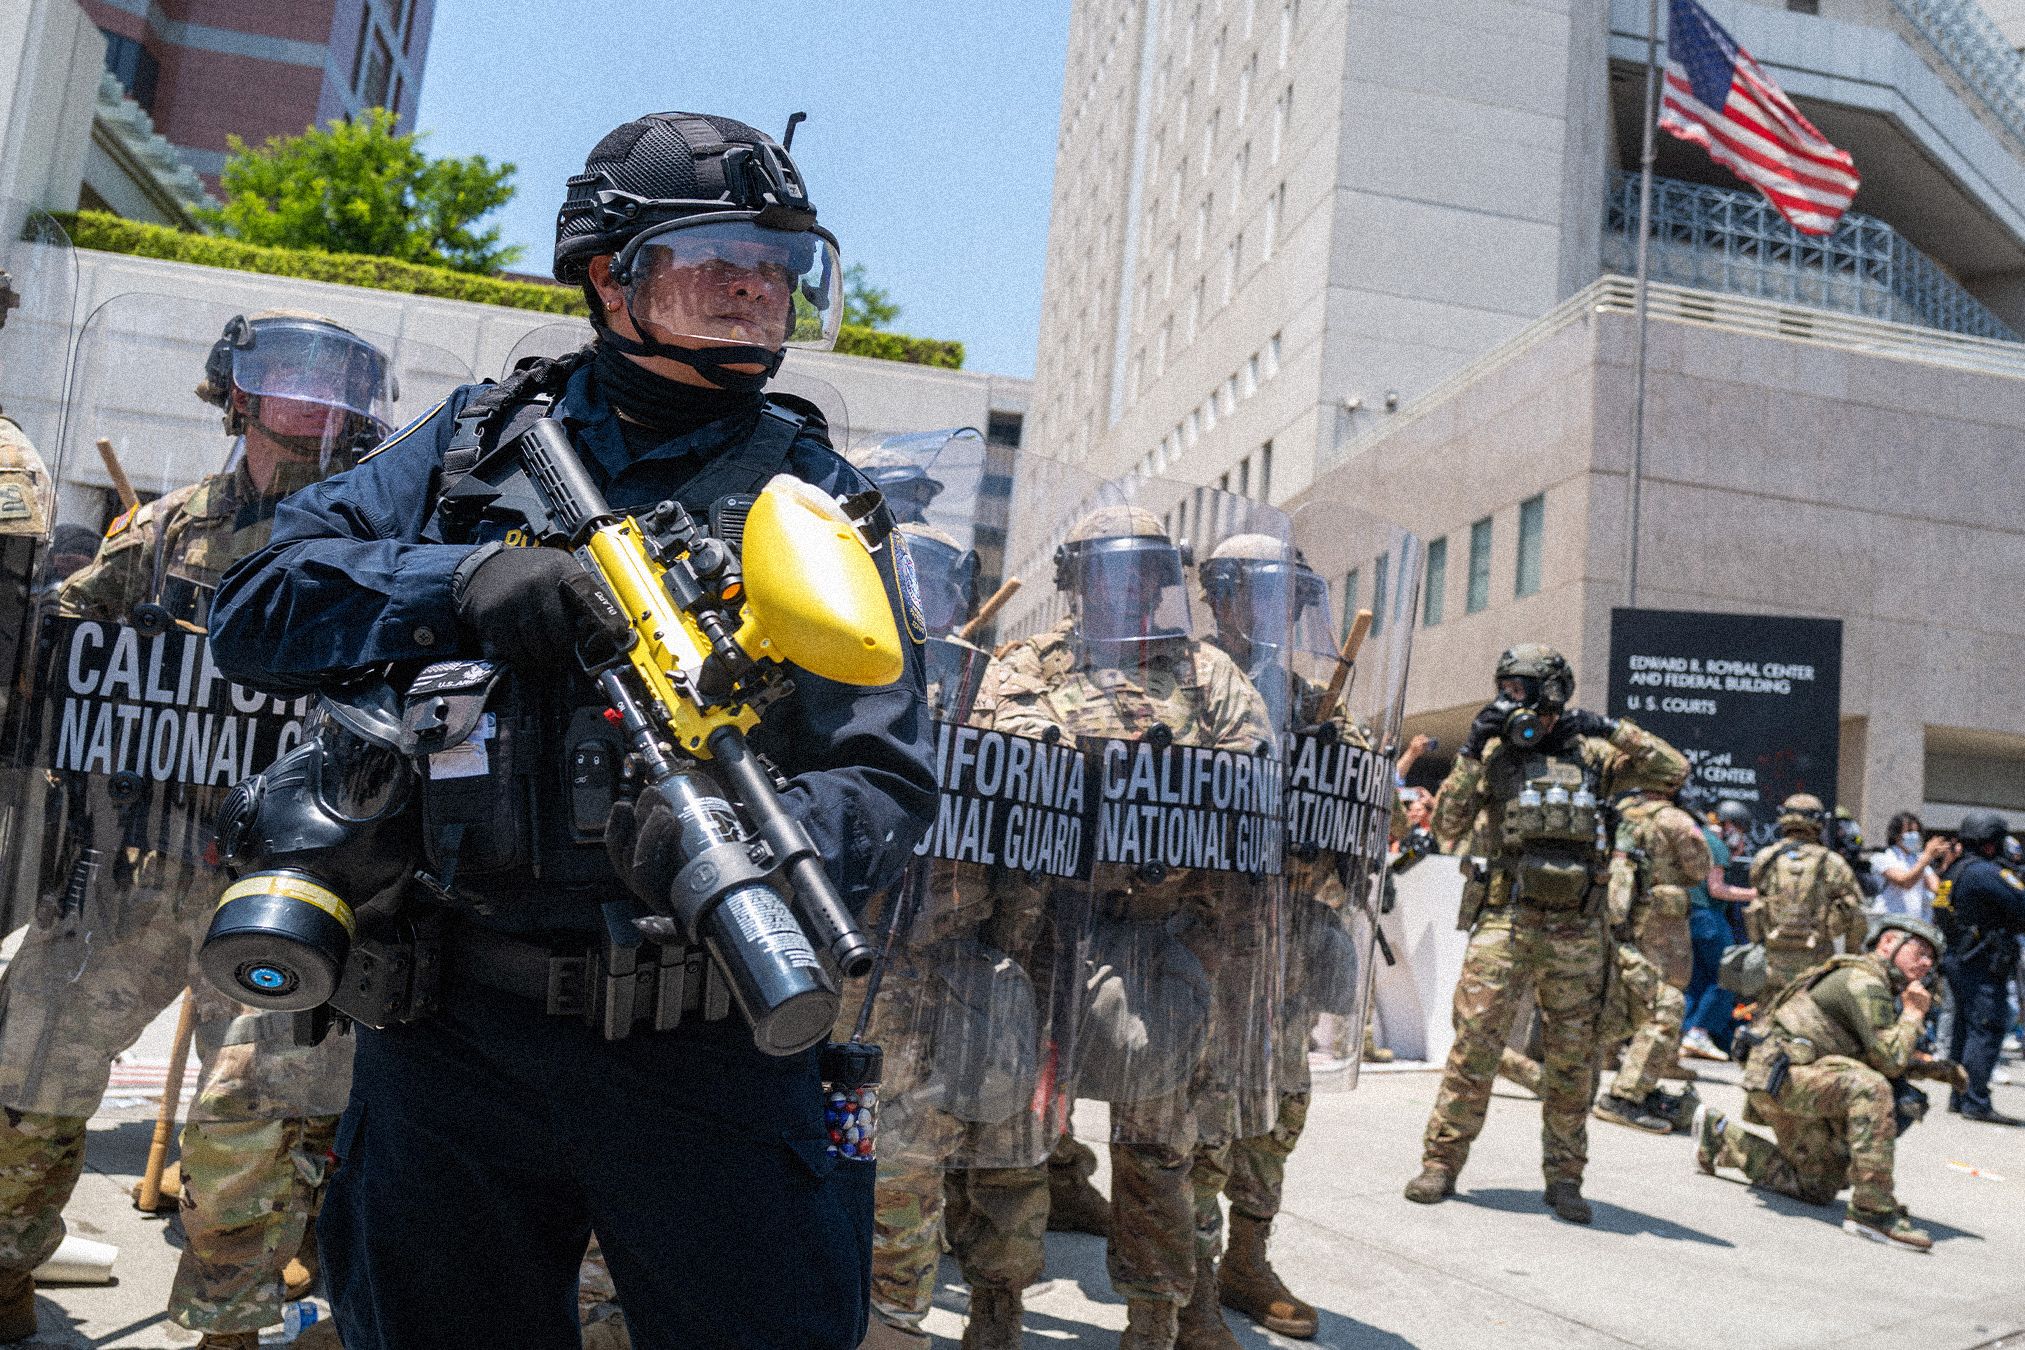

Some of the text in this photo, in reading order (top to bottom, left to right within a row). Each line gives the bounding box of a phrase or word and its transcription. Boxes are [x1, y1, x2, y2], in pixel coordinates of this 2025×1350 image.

[1629, 655, 1688, 672] EDWARD
[1690, 658, 1703, 673] R.
[1762, 662, 1815, 681] CENTER
[1629, 672, 1792, 695] AND FEDERAL BUILDING
[1662, 697, 1717, 715] COURTS
[56, 697, 257, 787] NATIONAL
[1703, 766, 1757, 784] CENTER
[1103, 739, 1282, 816] CALIFORNIA
[1004, 804, 1081, 877] GUARD
[1097, 801, 1231, 870] NATIONAL
[1286, 789, 1364, 856] ATIONAL
